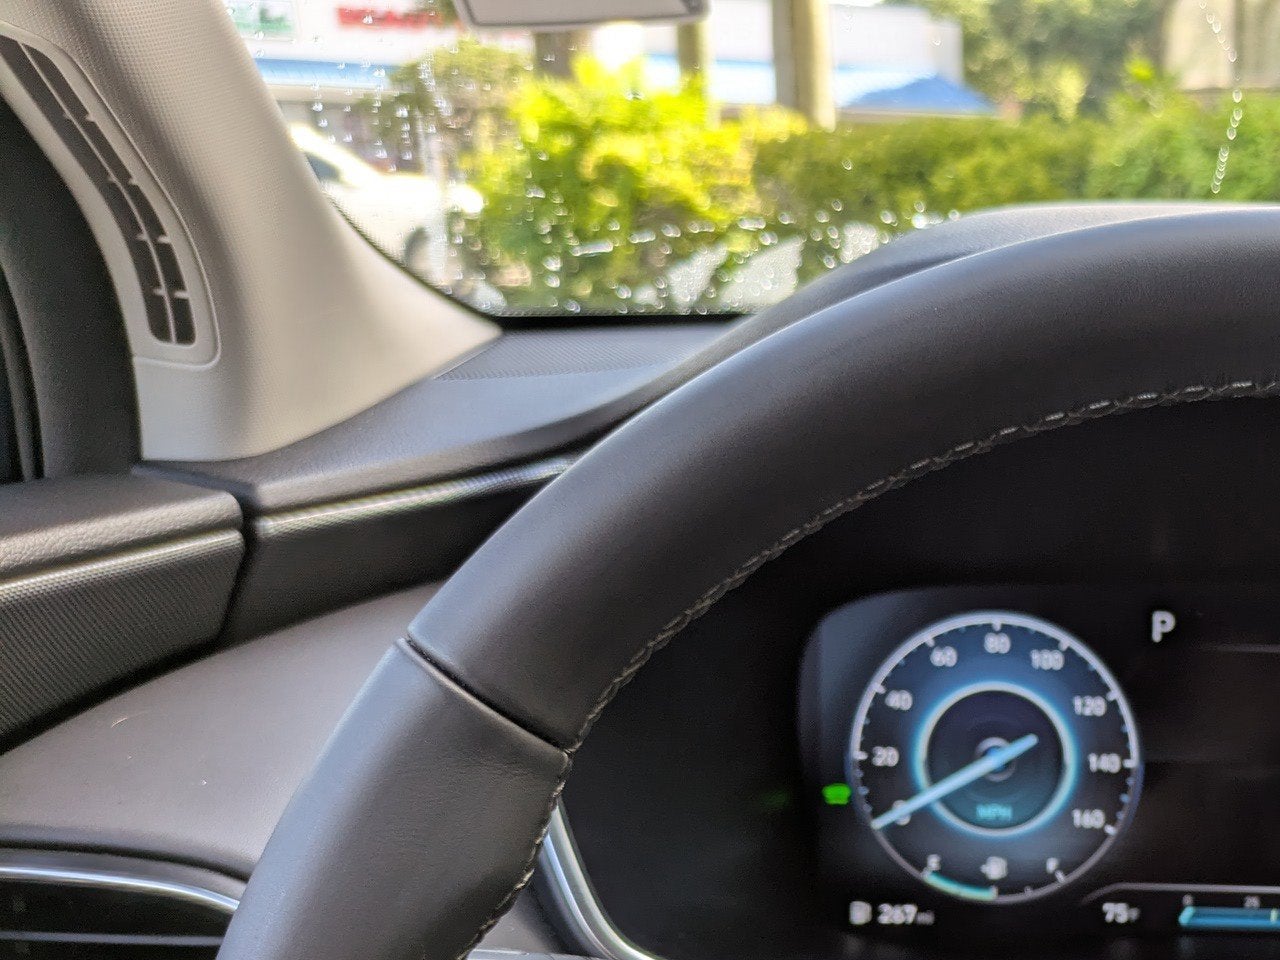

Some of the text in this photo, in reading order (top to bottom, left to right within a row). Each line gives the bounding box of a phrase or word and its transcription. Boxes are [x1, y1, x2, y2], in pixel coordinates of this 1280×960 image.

[1152, 611, 1175, 642] P
[984, 632, 1010, 654] 80
[1030, 649, 1064, 670] 100
[885, 689, 912, 711] 40
[1073, 695, 1106, 716] 120
[873, 746, 899, 767] 20
[1088, 753, 1122, 773] 140
[1073, 809, 1105, 829] 160
[877, 903, 917, 925] 267
